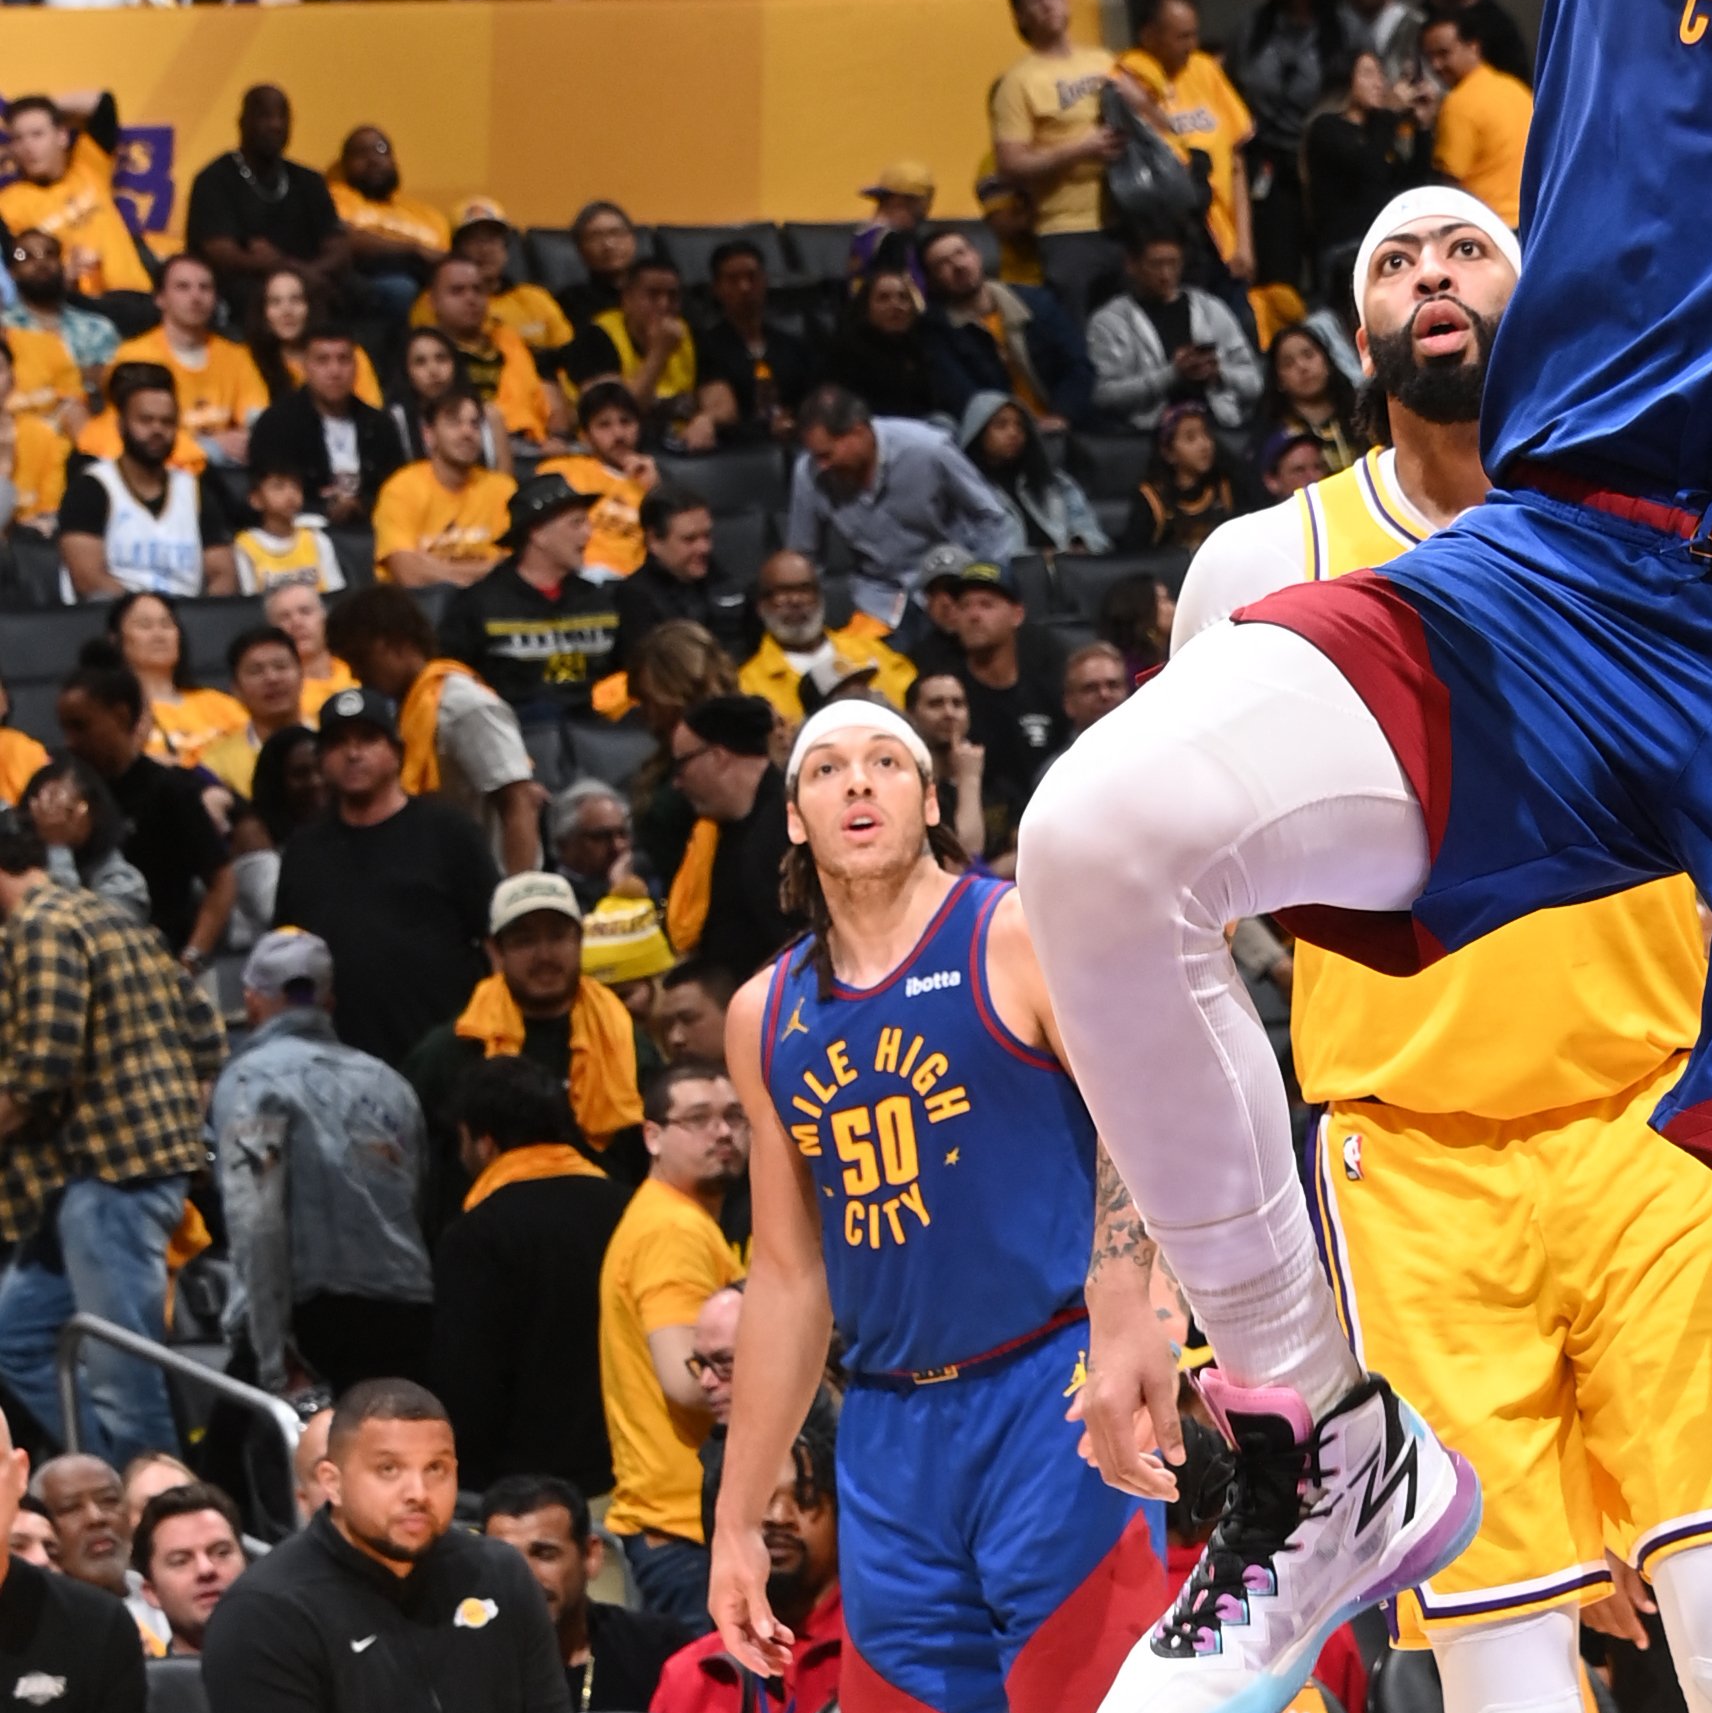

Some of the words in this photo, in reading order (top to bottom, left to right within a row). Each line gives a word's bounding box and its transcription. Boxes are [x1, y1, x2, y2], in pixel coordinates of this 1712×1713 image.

[905, 971, 961, 998] ibotta
[791, 1040, 858, 1157] MILE
[874, 1027, 971, 1124] HIGH
[830, 1095, 920, 1197] 50
[844, 1182, 931, 1250] CITY
